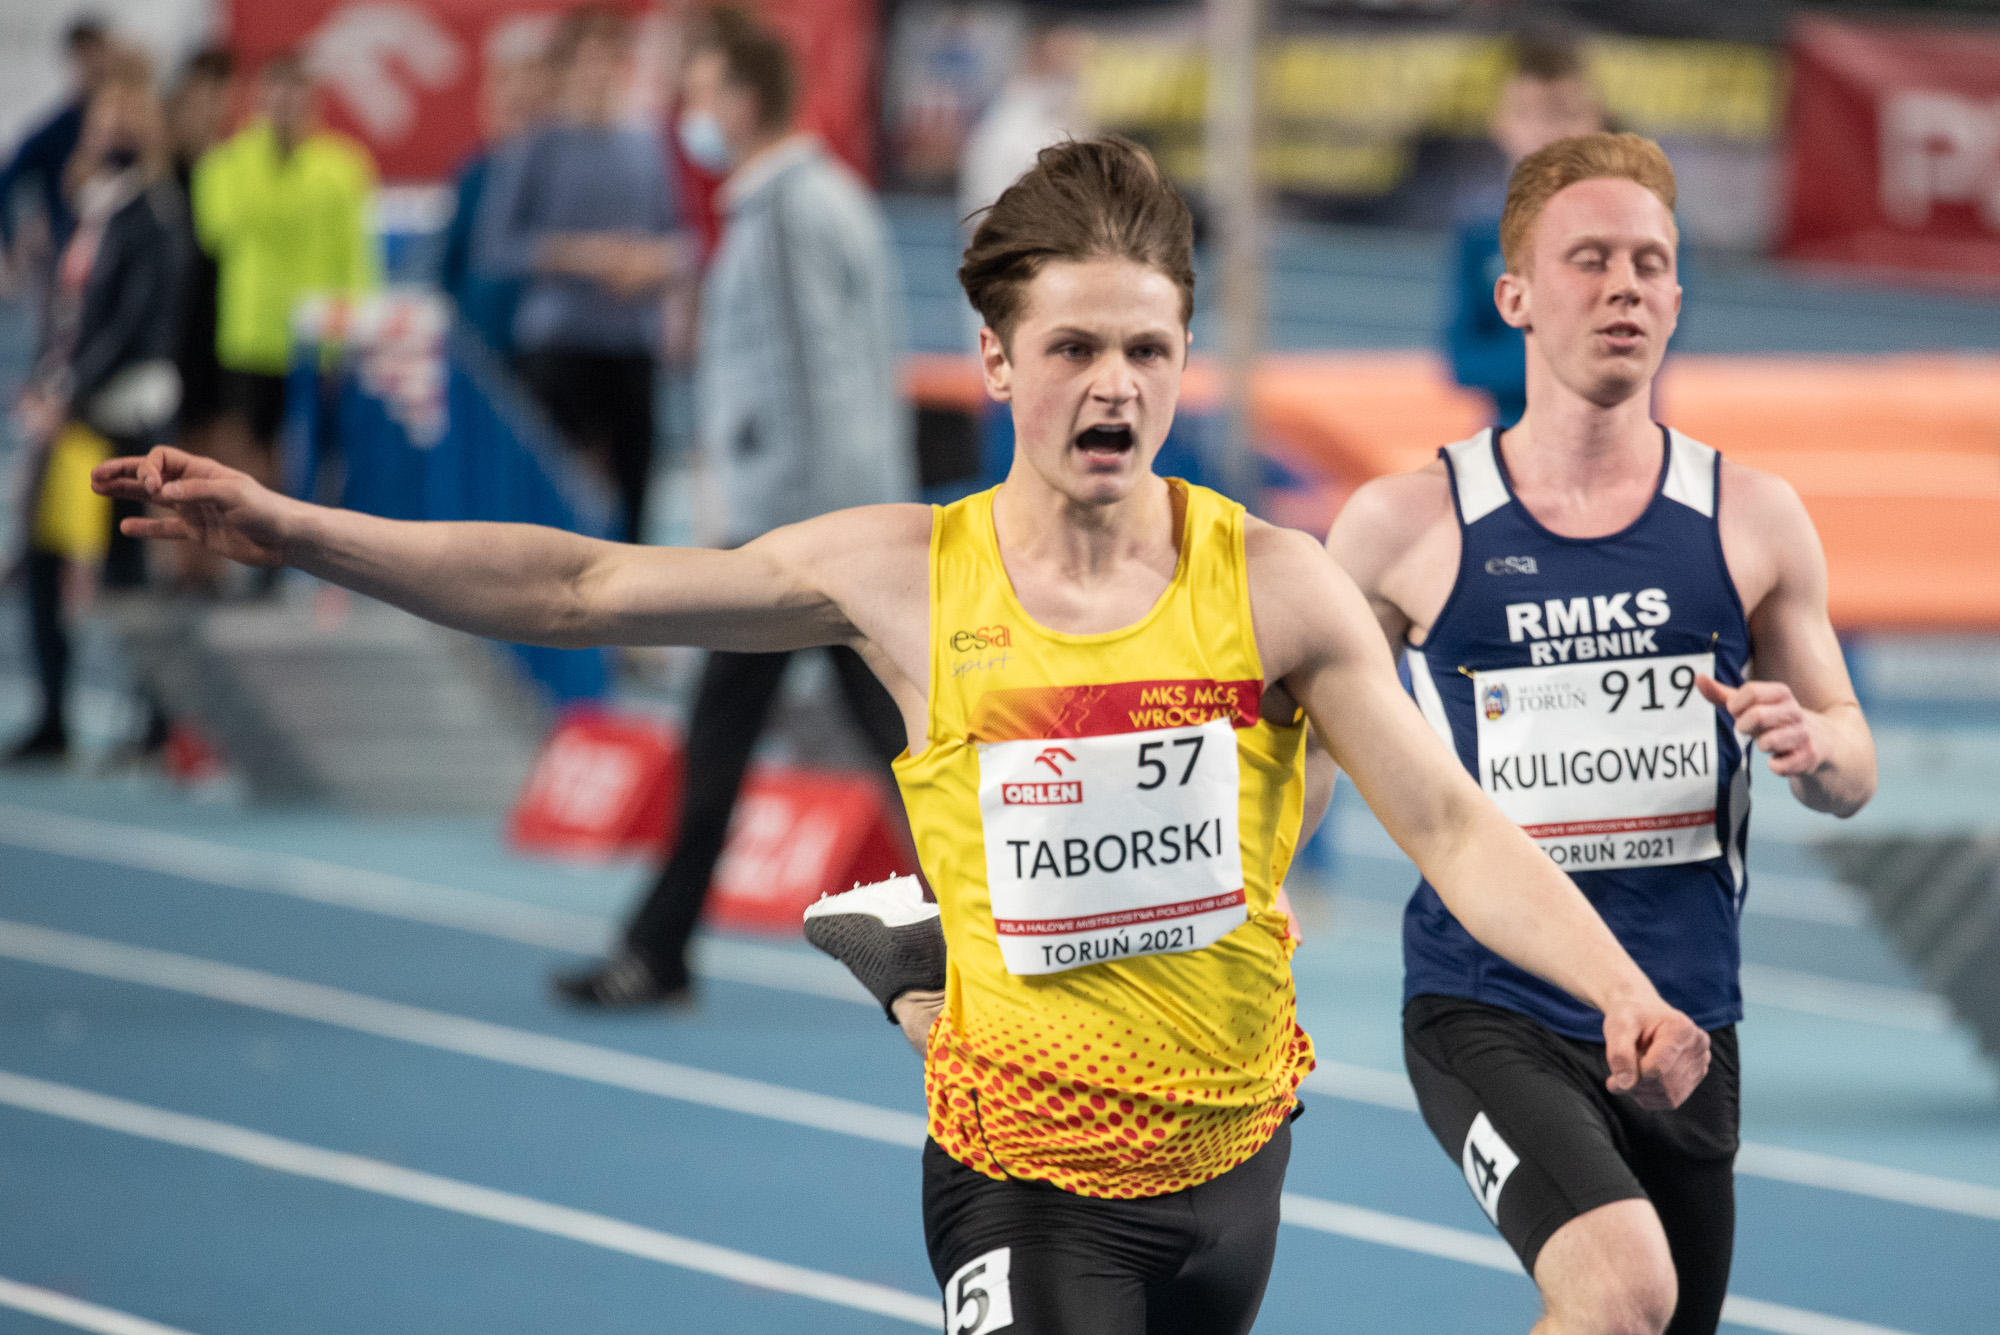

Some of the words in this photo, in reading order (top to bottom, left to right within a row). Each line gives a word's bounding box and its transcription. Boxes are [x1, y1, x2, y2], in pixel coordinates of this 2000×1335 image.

[1505, 587, 1671, 643] RMKS
[1529, 628, 1659, 666] RYBNIK
[1140, 685, 1187, 707] MKS
[1601, 665, 1696, 714] 919
[1136, 735, 1205, 791] 57
[1490, 741, 1709, 792] KULIGOWSKI
[1005, 784, 1079, 804] ORLEN
[1006, 818, 1223, 880] TABORSKI
[1624, 837, 1674, 860] 2021
[1156, 903, 1195, 918] POLSKI
[1041, 930, 1130, 966] TORUŃ
[1139, 925, 1195, 952] 2021
[1470, 1141, 1498, 1200] 4
[956, 1263, 990, 1335] 5
